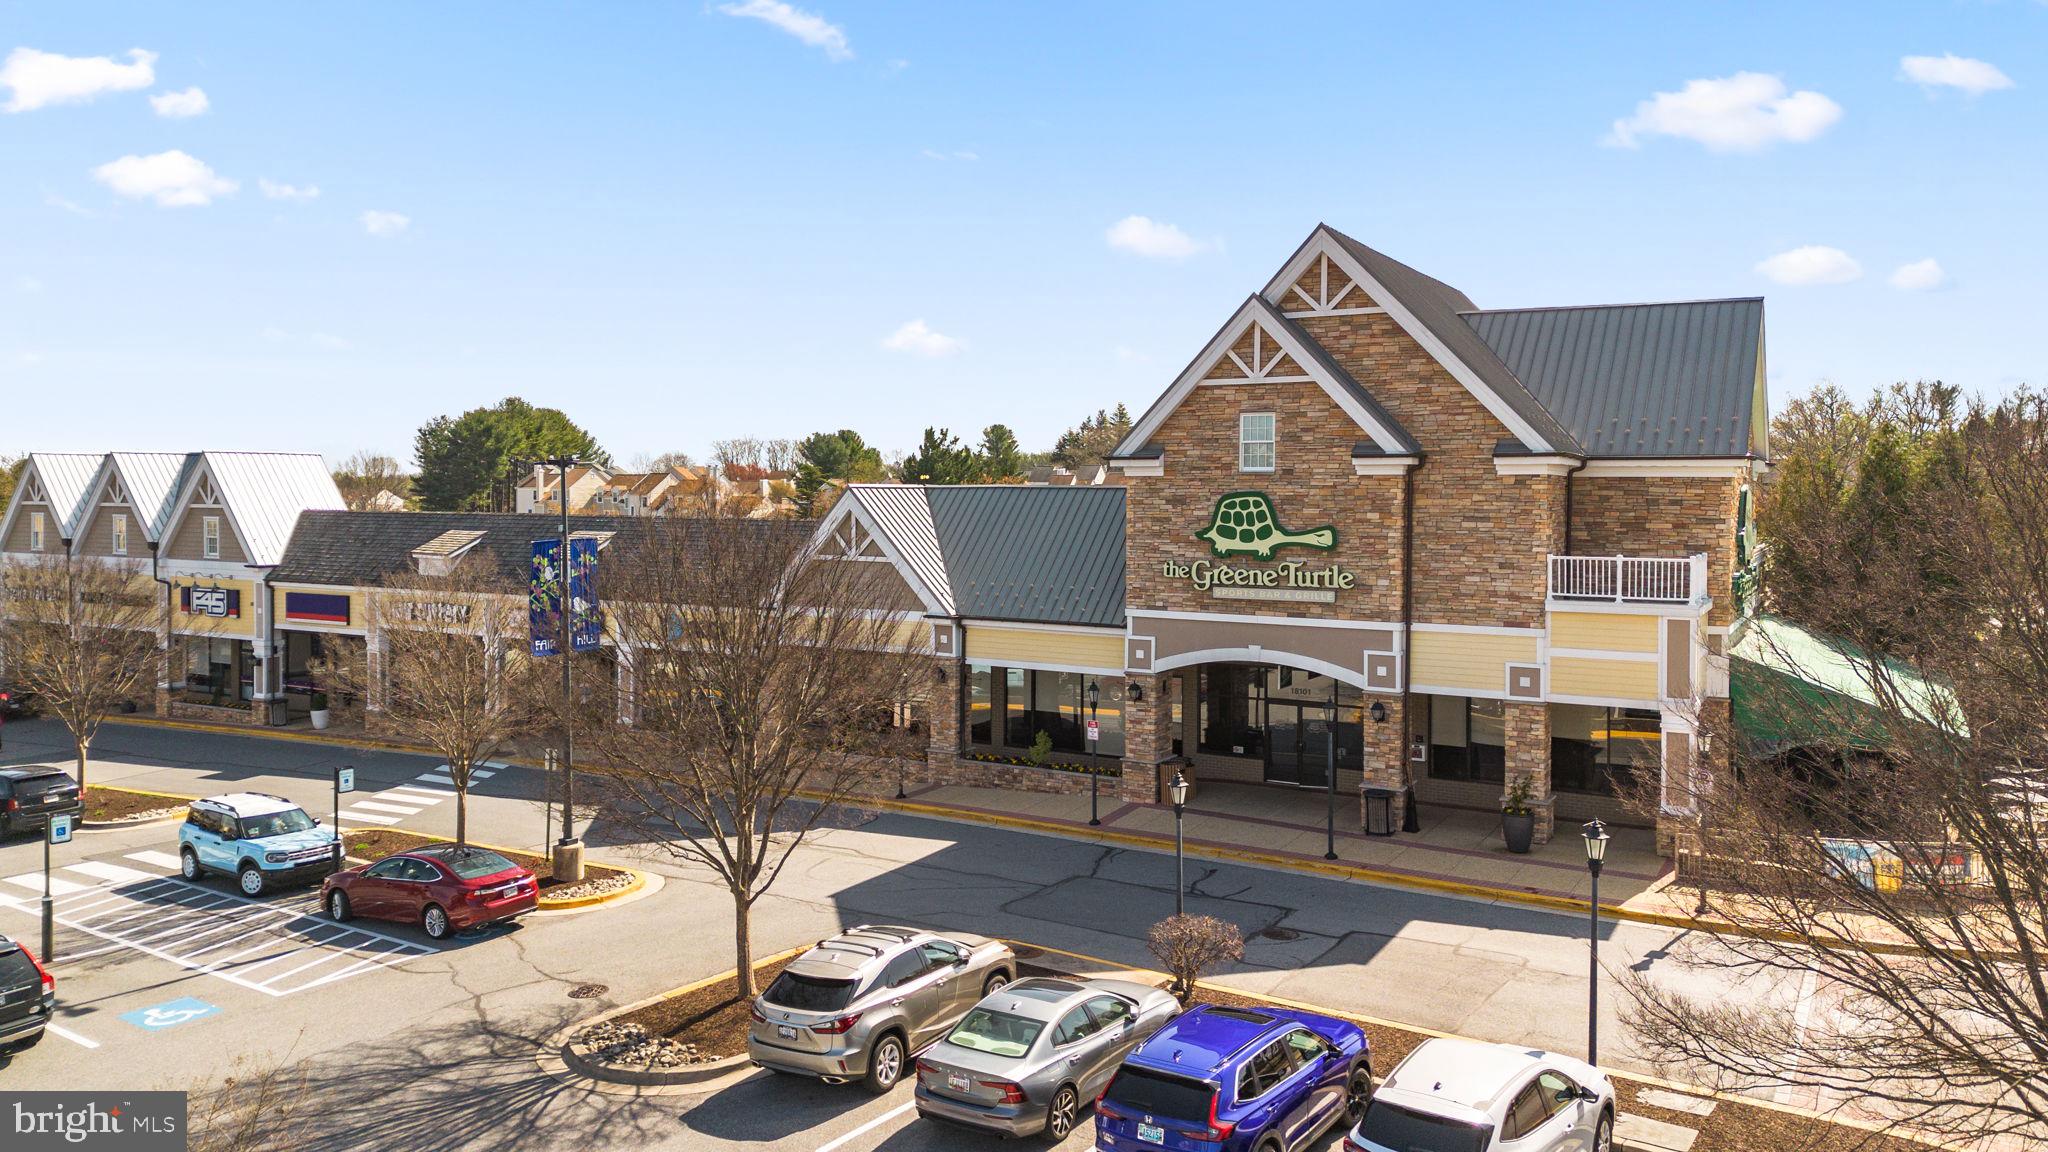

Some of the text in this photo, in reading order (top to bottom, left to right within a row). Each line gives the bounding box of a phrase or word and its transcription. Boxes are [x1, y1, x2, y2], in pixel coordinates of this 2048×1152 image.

[1163, 560, 1355, 590] the Greene Turtle
[192, 590, 225, 615] F45
[1215, 588, 1255, 598] SPORTS
[1259, 590, 1281, 599] BAR
[1295, 591, 1334, 601] GRILLE
